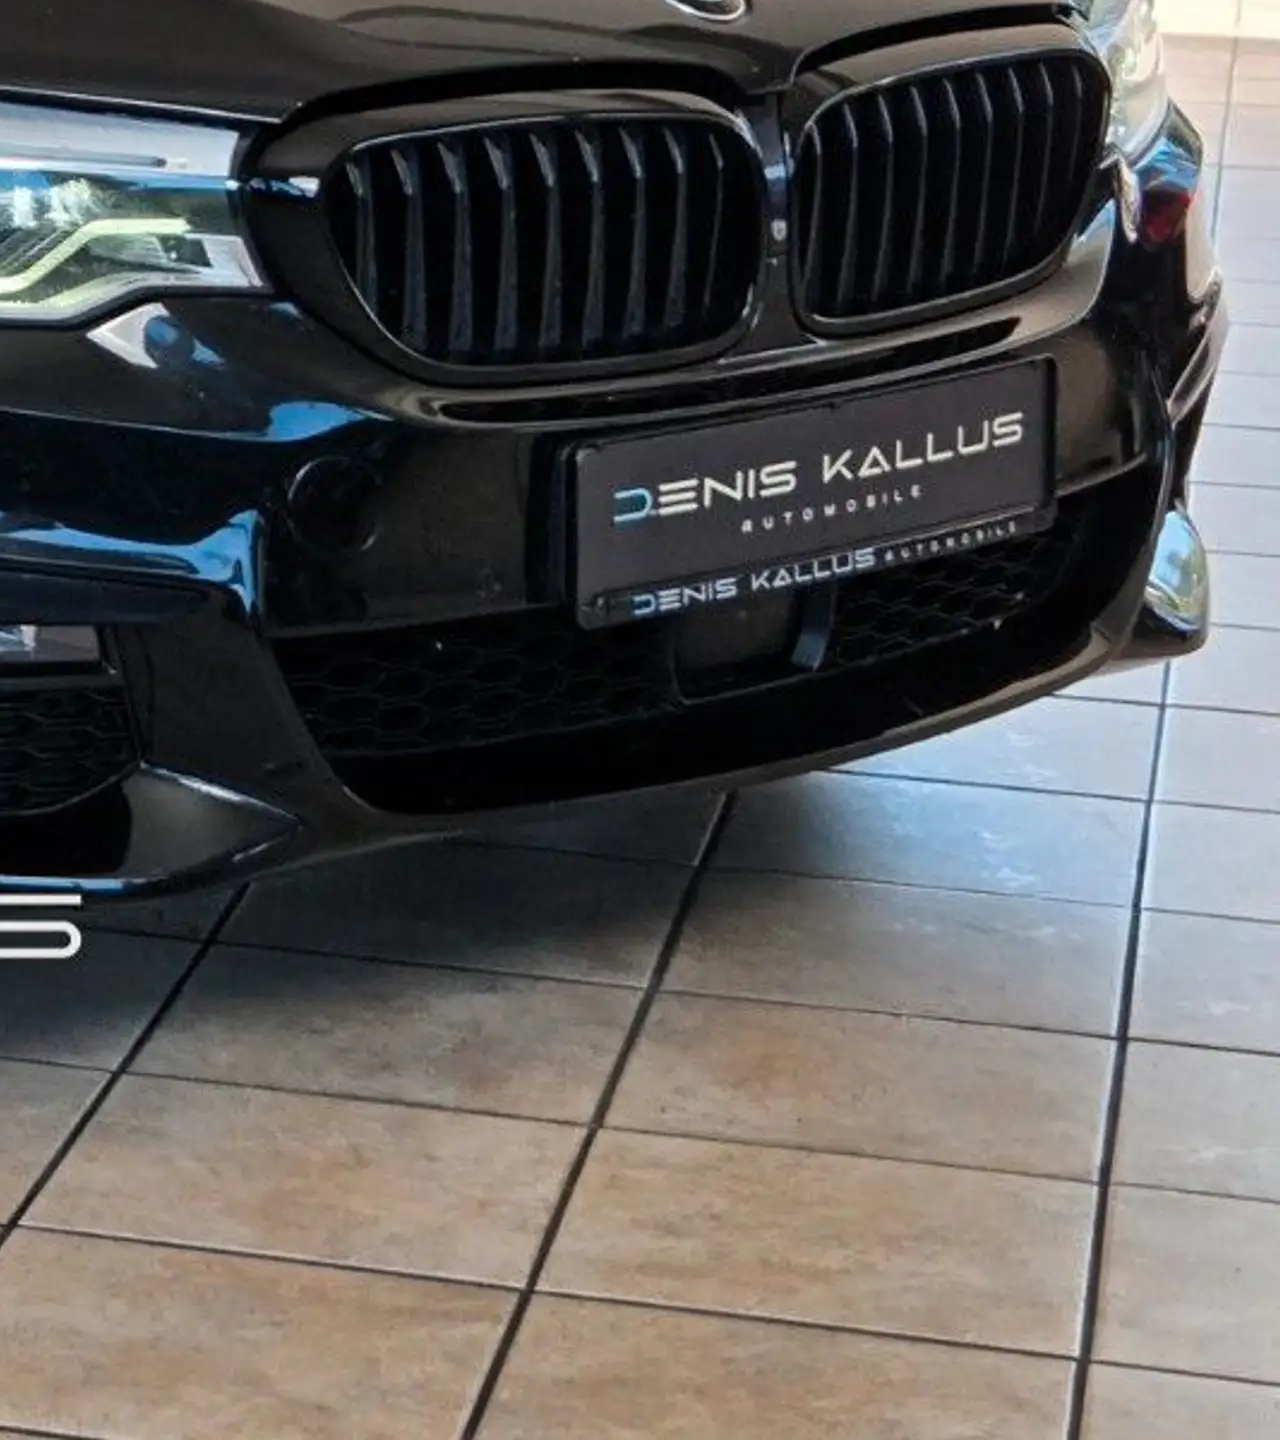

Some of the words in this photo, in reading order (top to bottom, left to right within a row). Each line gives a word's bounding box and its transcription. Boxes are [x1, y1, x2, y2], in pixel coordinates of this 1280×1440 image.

[612, 460, 797, 523] DENIS
[821, 411, 1024, 485] KALLUS
[740, 484, 923, 534] AUTOMOBILE
[632, 577, 738, 617] DENIS
[750, 546, 877, 592] KALLUS
